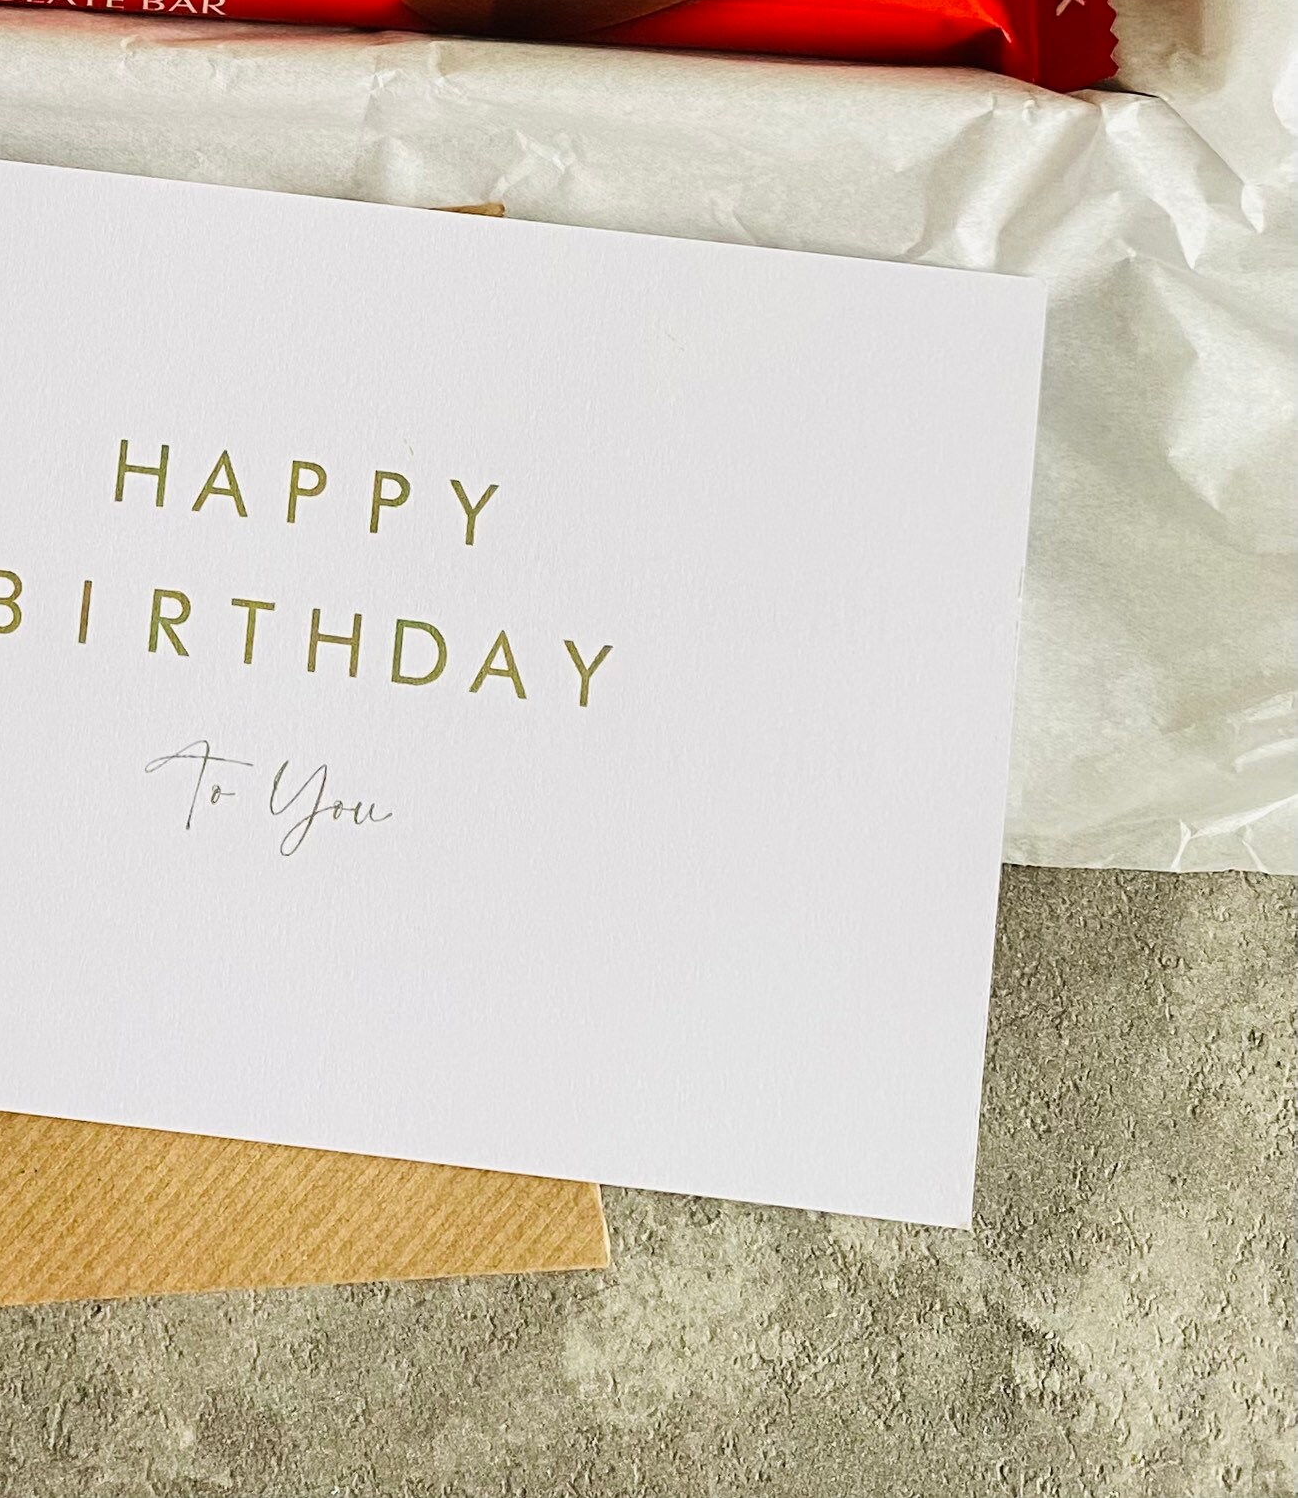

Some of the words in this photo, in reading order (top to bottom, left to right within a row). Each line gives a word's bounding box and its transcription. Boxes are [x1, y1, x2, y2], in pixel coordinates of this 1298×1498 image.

[114, 438, 500, 547] HAPPY
[144, 739, 254, 831] To
[269, 759, 393, 857] You
